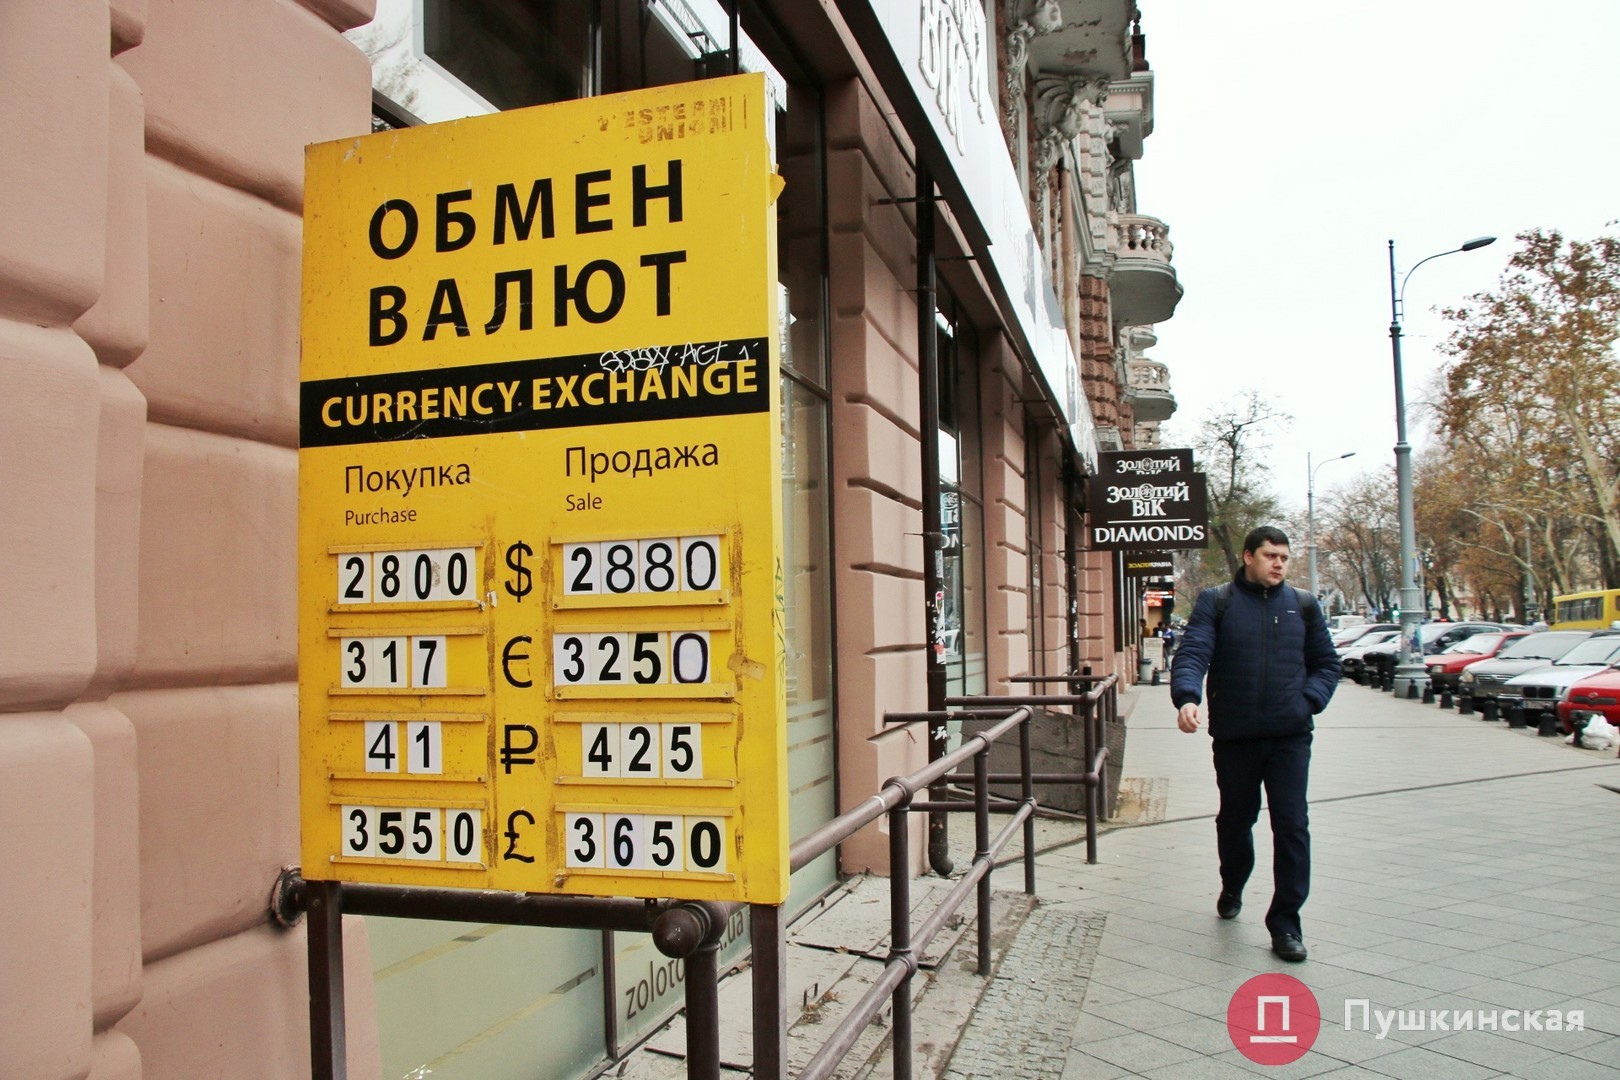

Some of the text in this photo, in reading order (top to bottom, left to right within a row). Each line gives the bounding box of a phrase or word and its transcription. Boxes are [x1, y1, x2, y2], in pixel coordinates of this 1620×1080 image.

[368, 159, 685, 260] ОБМЕН
[368, 249, 688, 347] ВАЛЮТ
[321, 380, 521, 428] CURRENCY
[532, 359, 758, 410] EXCHANGE
[344, 461, 472, 498] Покупка
[564, 442, 720, 483] Продажа
[344, 507, 418, 527] Purchase
[565, 493, 603, 512] Sale
[1094, 525, 1205, 543] DIAMONDS
[343, 540, 717, 604] 2800 $ 2880
[501, 635, 533, 689] €
[563, 631, 709, 685] 3250
[368, 724, 431, 770] 41
[587, 725, 695, 774] 425
[348, 807, 722, 869] 3550 £ 3650
